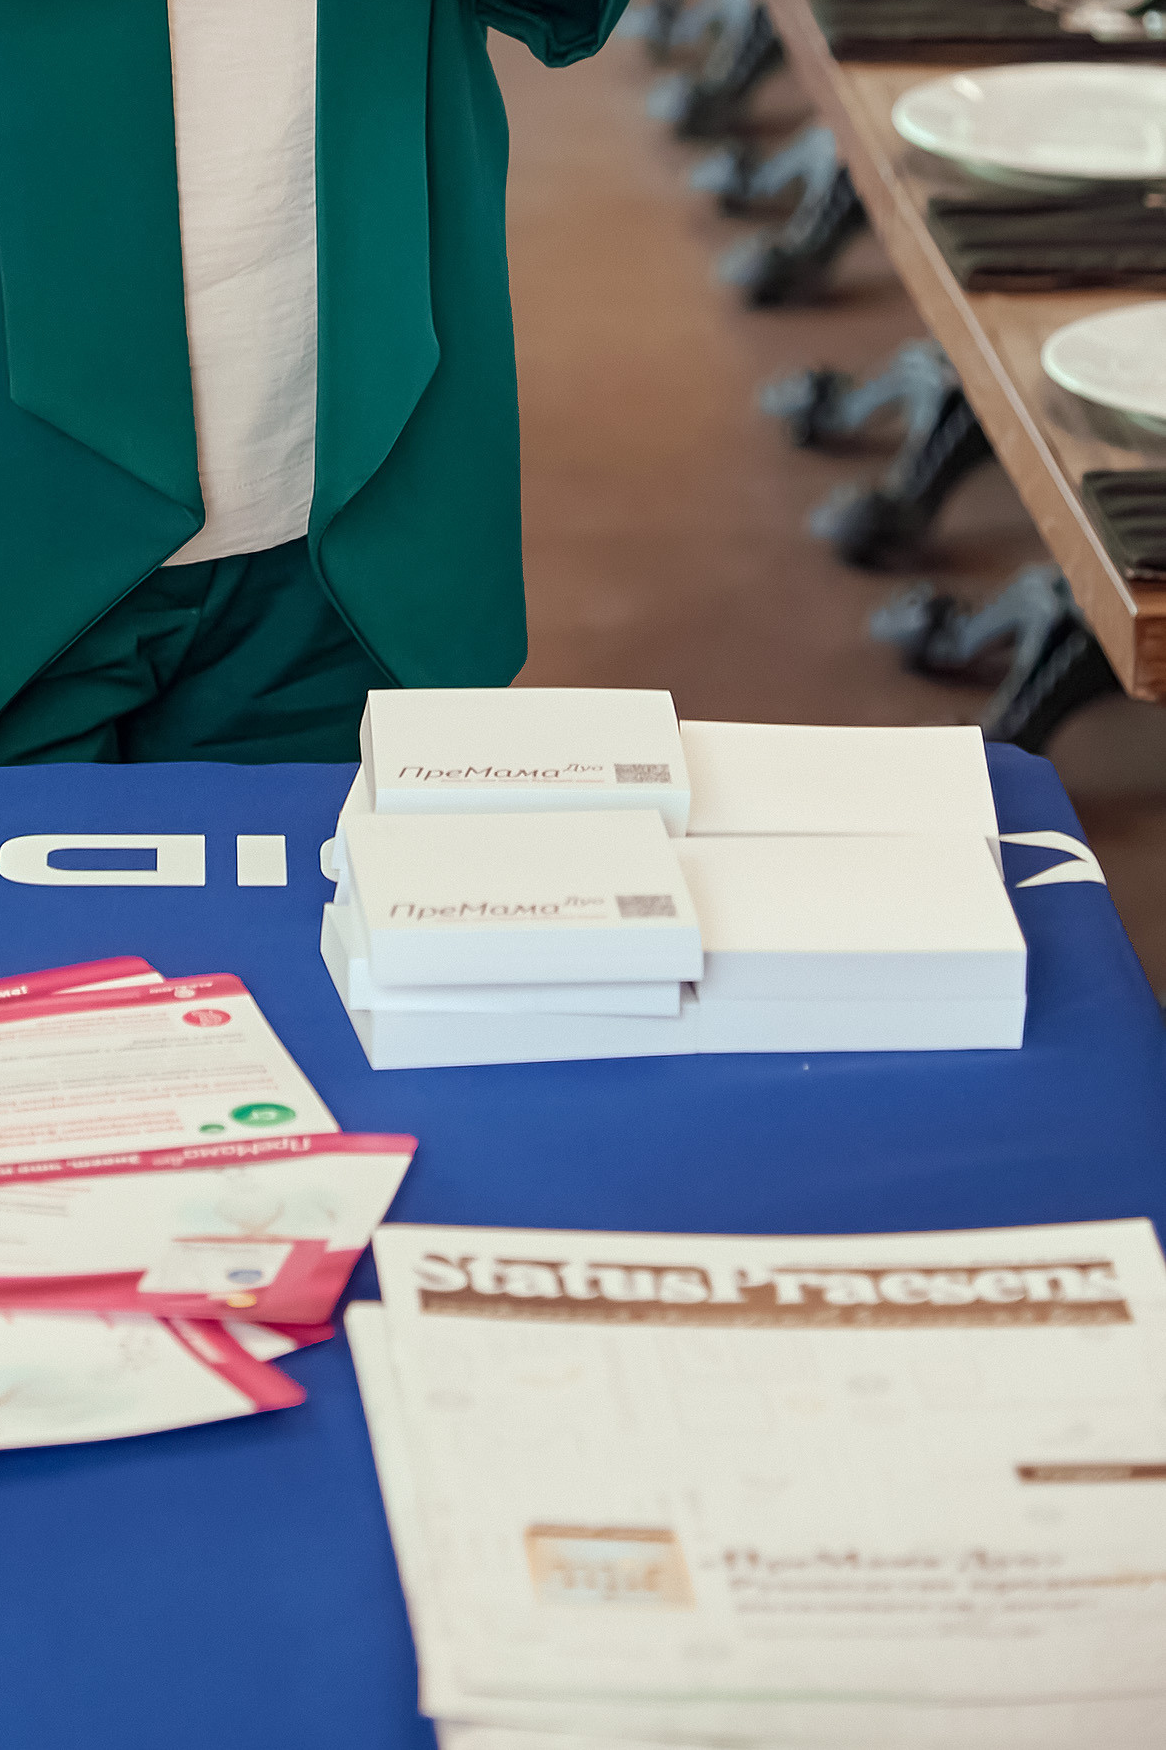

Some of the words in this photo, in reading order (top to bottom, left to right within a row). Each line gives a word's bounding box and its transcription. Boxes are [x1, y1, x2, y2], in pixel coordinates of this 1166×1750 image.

[398, 765, 562, 782] ПреМама
[389, 901, 562, 922] ПреМама
[414, 1251, 1125, 1306] StatusPraesens
